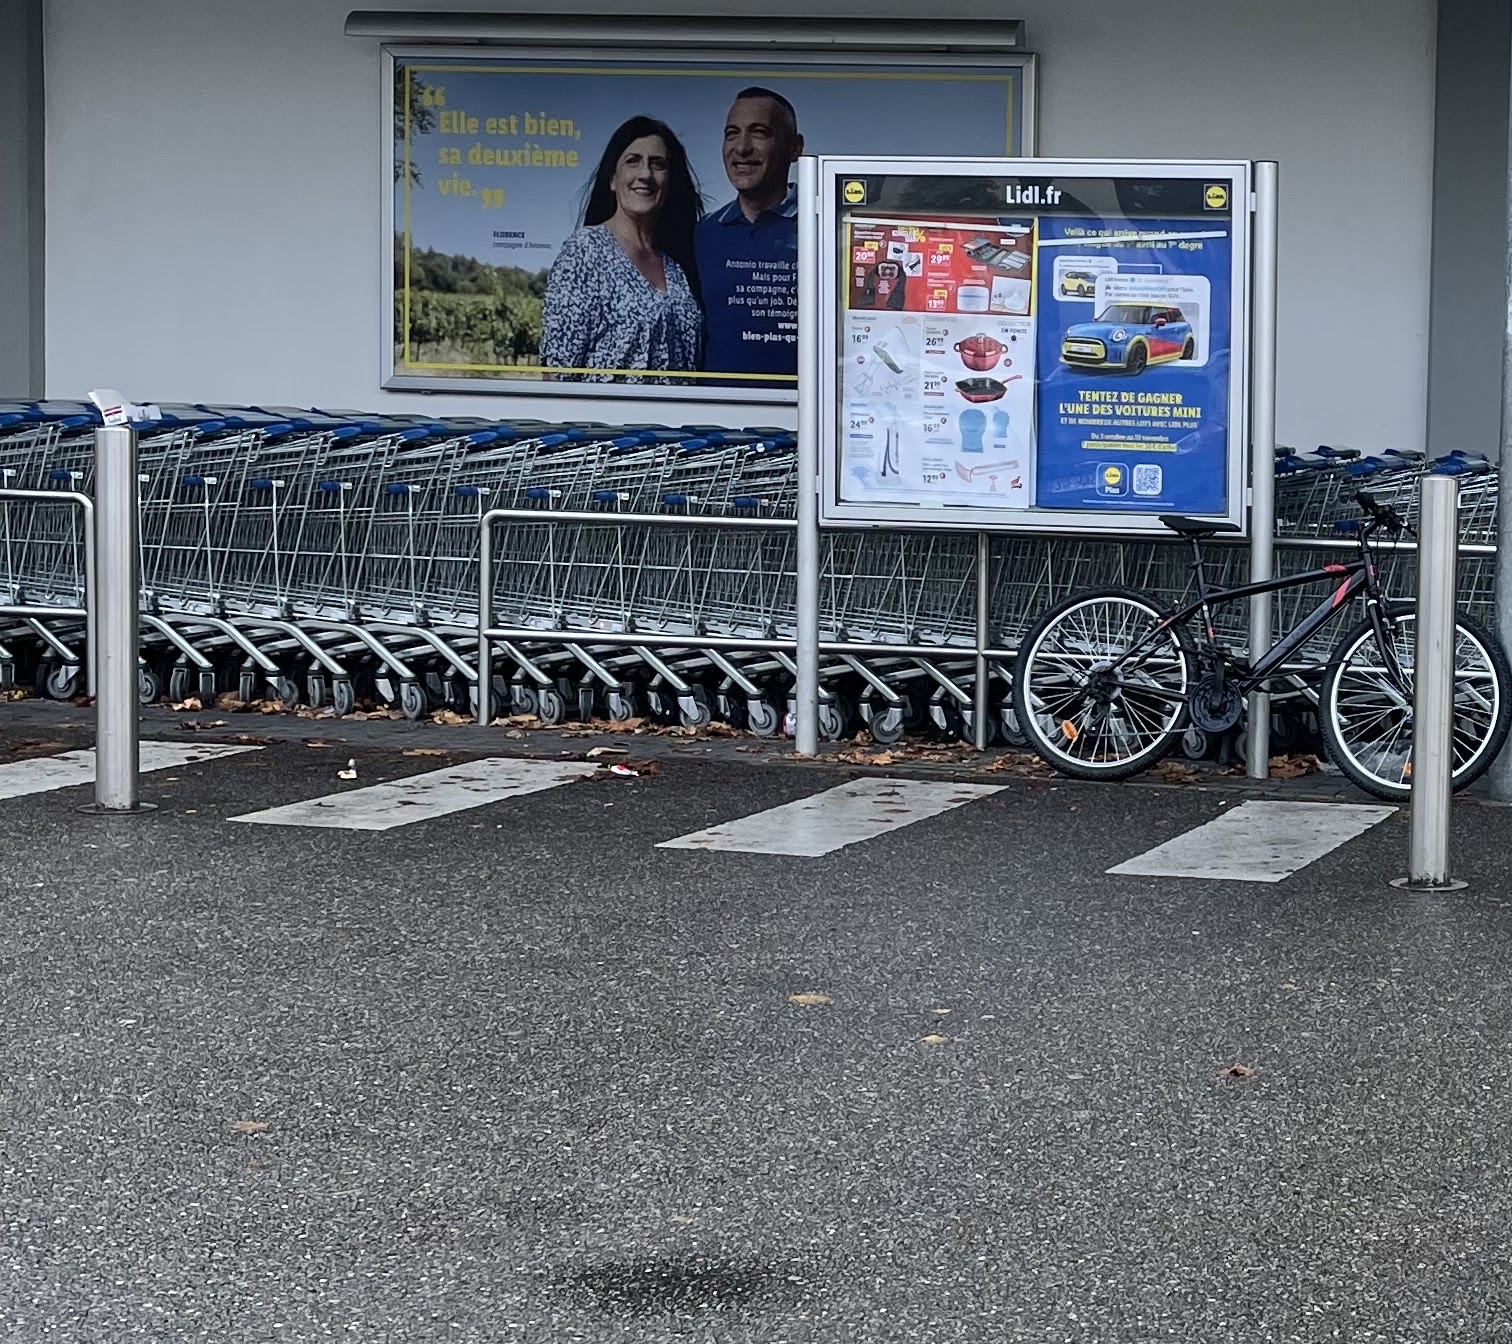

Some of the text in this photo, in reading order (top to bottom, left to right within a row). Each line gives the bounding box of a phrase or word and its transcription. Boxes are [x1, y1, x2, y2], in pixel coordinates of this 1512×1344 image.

[438, 111, 581, 140] Elle est bien,
[438, 142, 579, 167] sa deuxième
[1006, 185, 1062, 205] Lidl.fr
[726, 259, 757, 269] Antonio
[758, 260, 790, 269] travaille
[752, 272, 771, 281] Mais
[772, 273, 791, 283] pour
[728, 296, 745, 305] plus
[747, 297, 769, 306] qu'un
[751, 309, 766, 317] son
[1078, 390, 1183, 404] TENTEZ DE GAGNER
[1059, 403, 1202, 419] L'UNE DES VOITURES MINI
